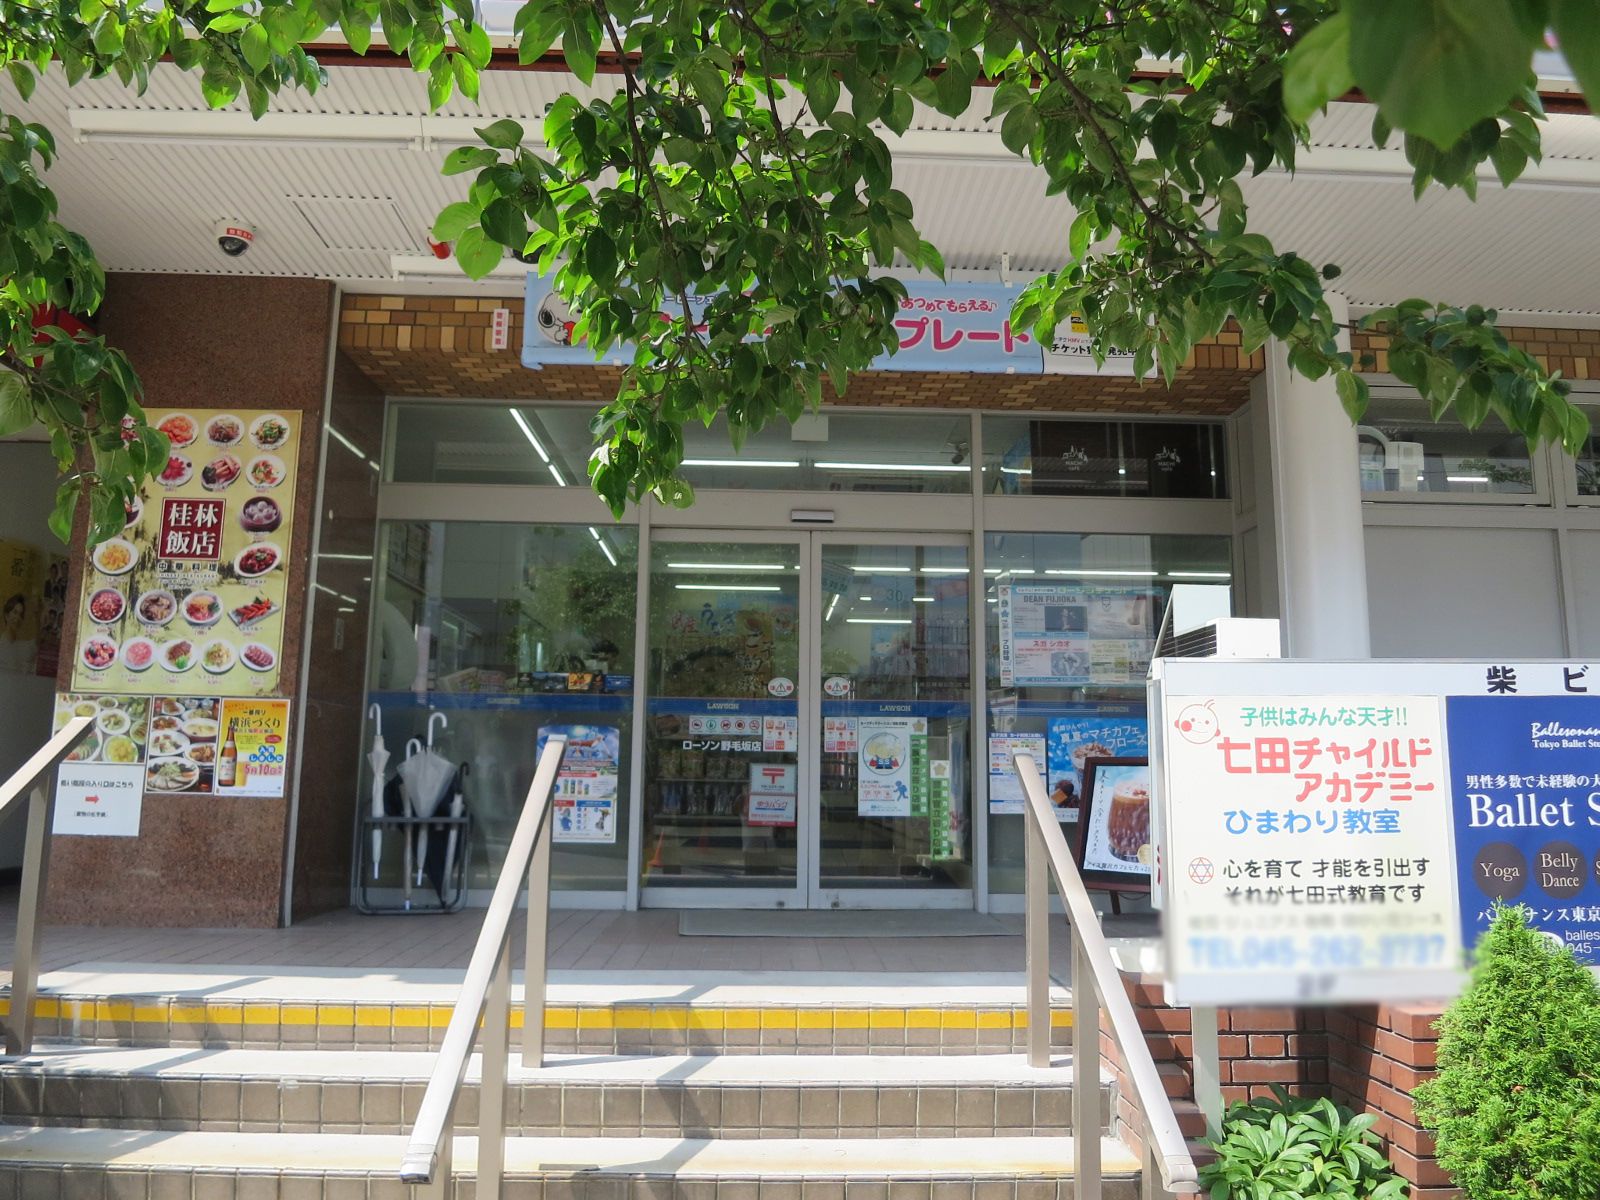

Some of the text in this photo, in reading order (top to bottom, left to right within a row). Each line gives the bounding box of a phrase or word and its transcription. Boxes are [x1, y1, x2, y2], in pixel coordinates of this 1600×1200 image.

[168, 502, 219, 528] 桂林
[165, 530, 217, 556] 飯店
[1240, 706, 1408, 727] 子供はみんな天才!!
[1217, 737, 1432, 774] 七田チャイルド
[1532, 740, 1559, 750] Tokyo
[1561, 739, 1586, 748] Ballet
[1294, 771, 1434, 803] アカデミー
[1223, 808, 1401, 835] ひまわり教室
[1466, 793, 1576, 828] Ballet
[1480, 862, 1520, 882] Yoga
[1540, 853, 1578, 872] Belly
[1542, 872, 1580, 888] Dance
